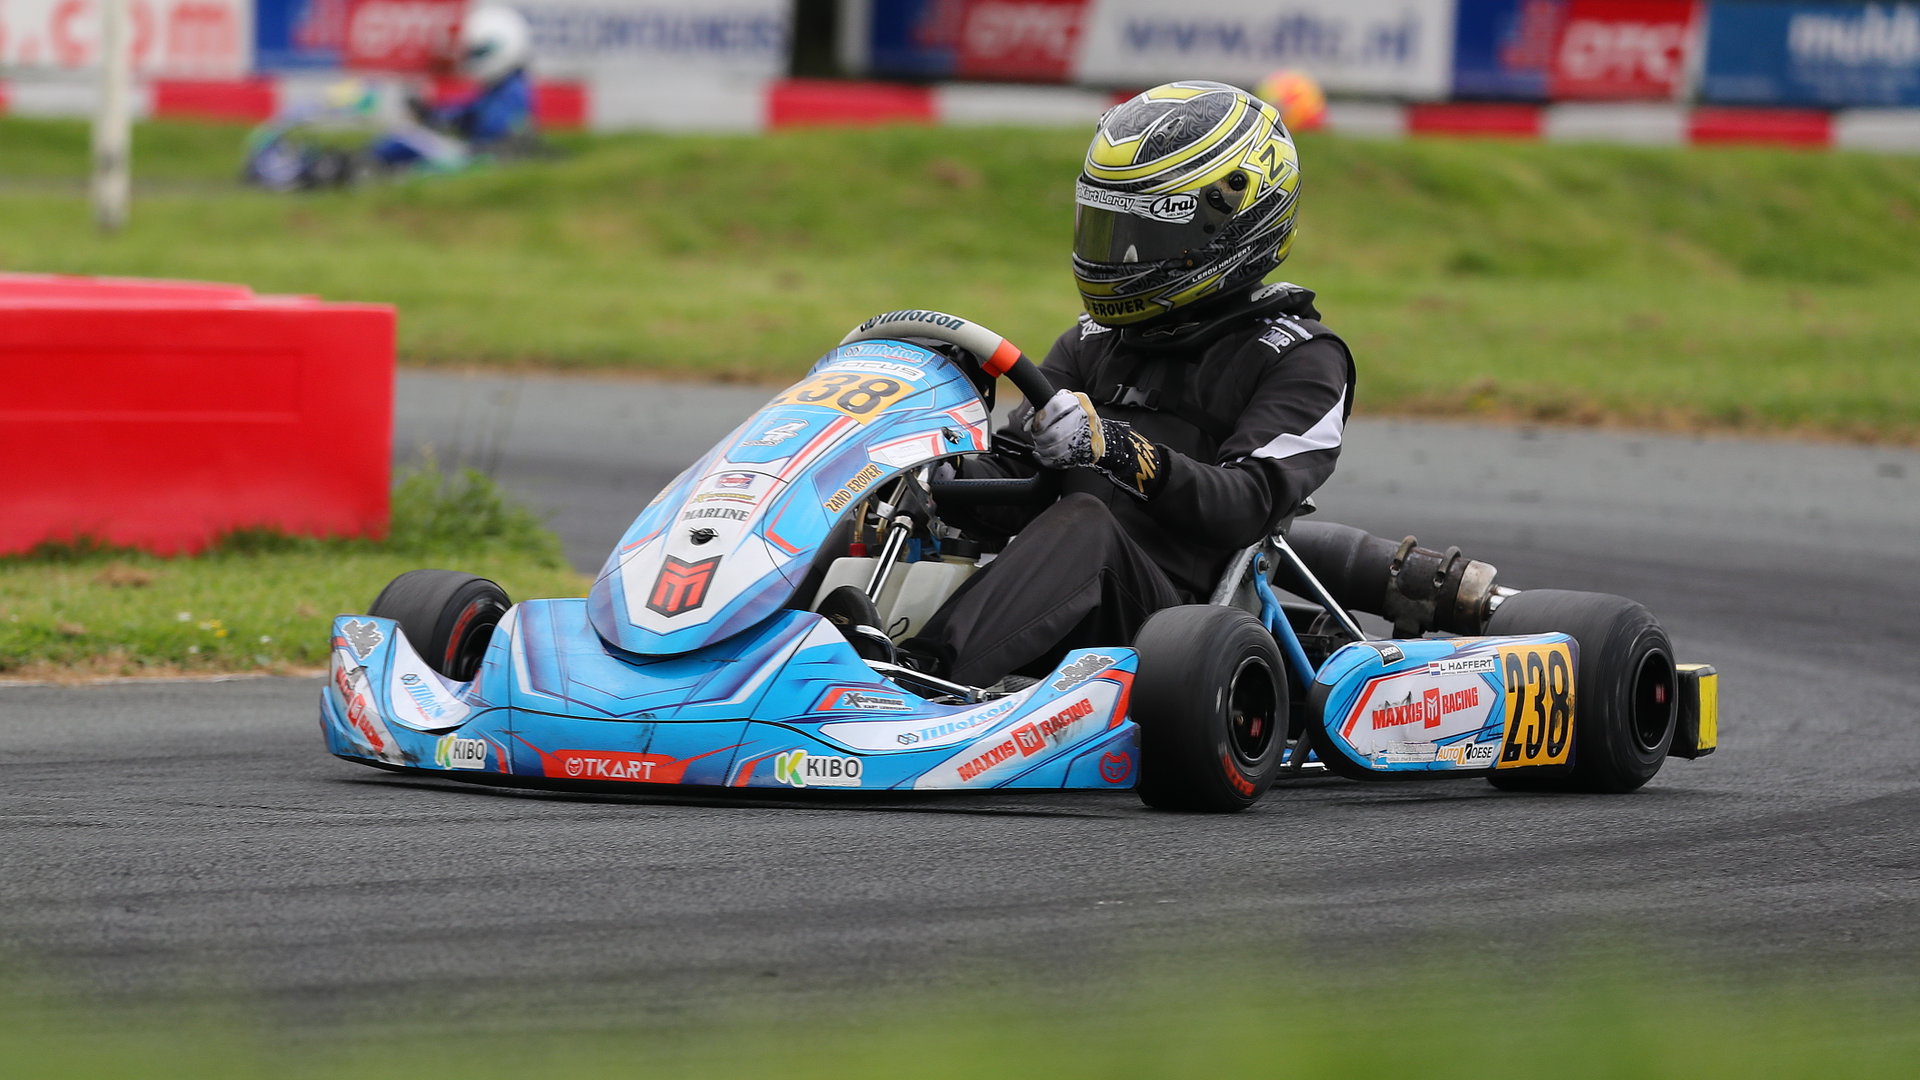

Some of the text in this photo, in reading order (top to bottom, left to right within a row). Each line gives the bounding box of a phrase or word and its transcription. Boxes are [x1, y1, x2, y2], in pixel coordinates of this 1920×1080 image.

[1099, 189, 1136, 211] Leroy
[1154, 197, 1196, 214] Arai
[1218, 245, 1252, 269] HAFFERT
[1091, 299, 1146, 317] EROVER
[825, 463, 883, 512] ZAND EROVER
[1440, 659, 1493, 671] L HAFFERT
[1372, 686, 1479, 730] MAXXIS RACING
[1501, 650, 1569, 763] 238
[956, 698, 1095, 782] MAXXIS RACING
[453, 741, 486, 761] KIBO
[1438, 748, 1460, 760] AUTO
[807, 758, 860, 778] KIBO
